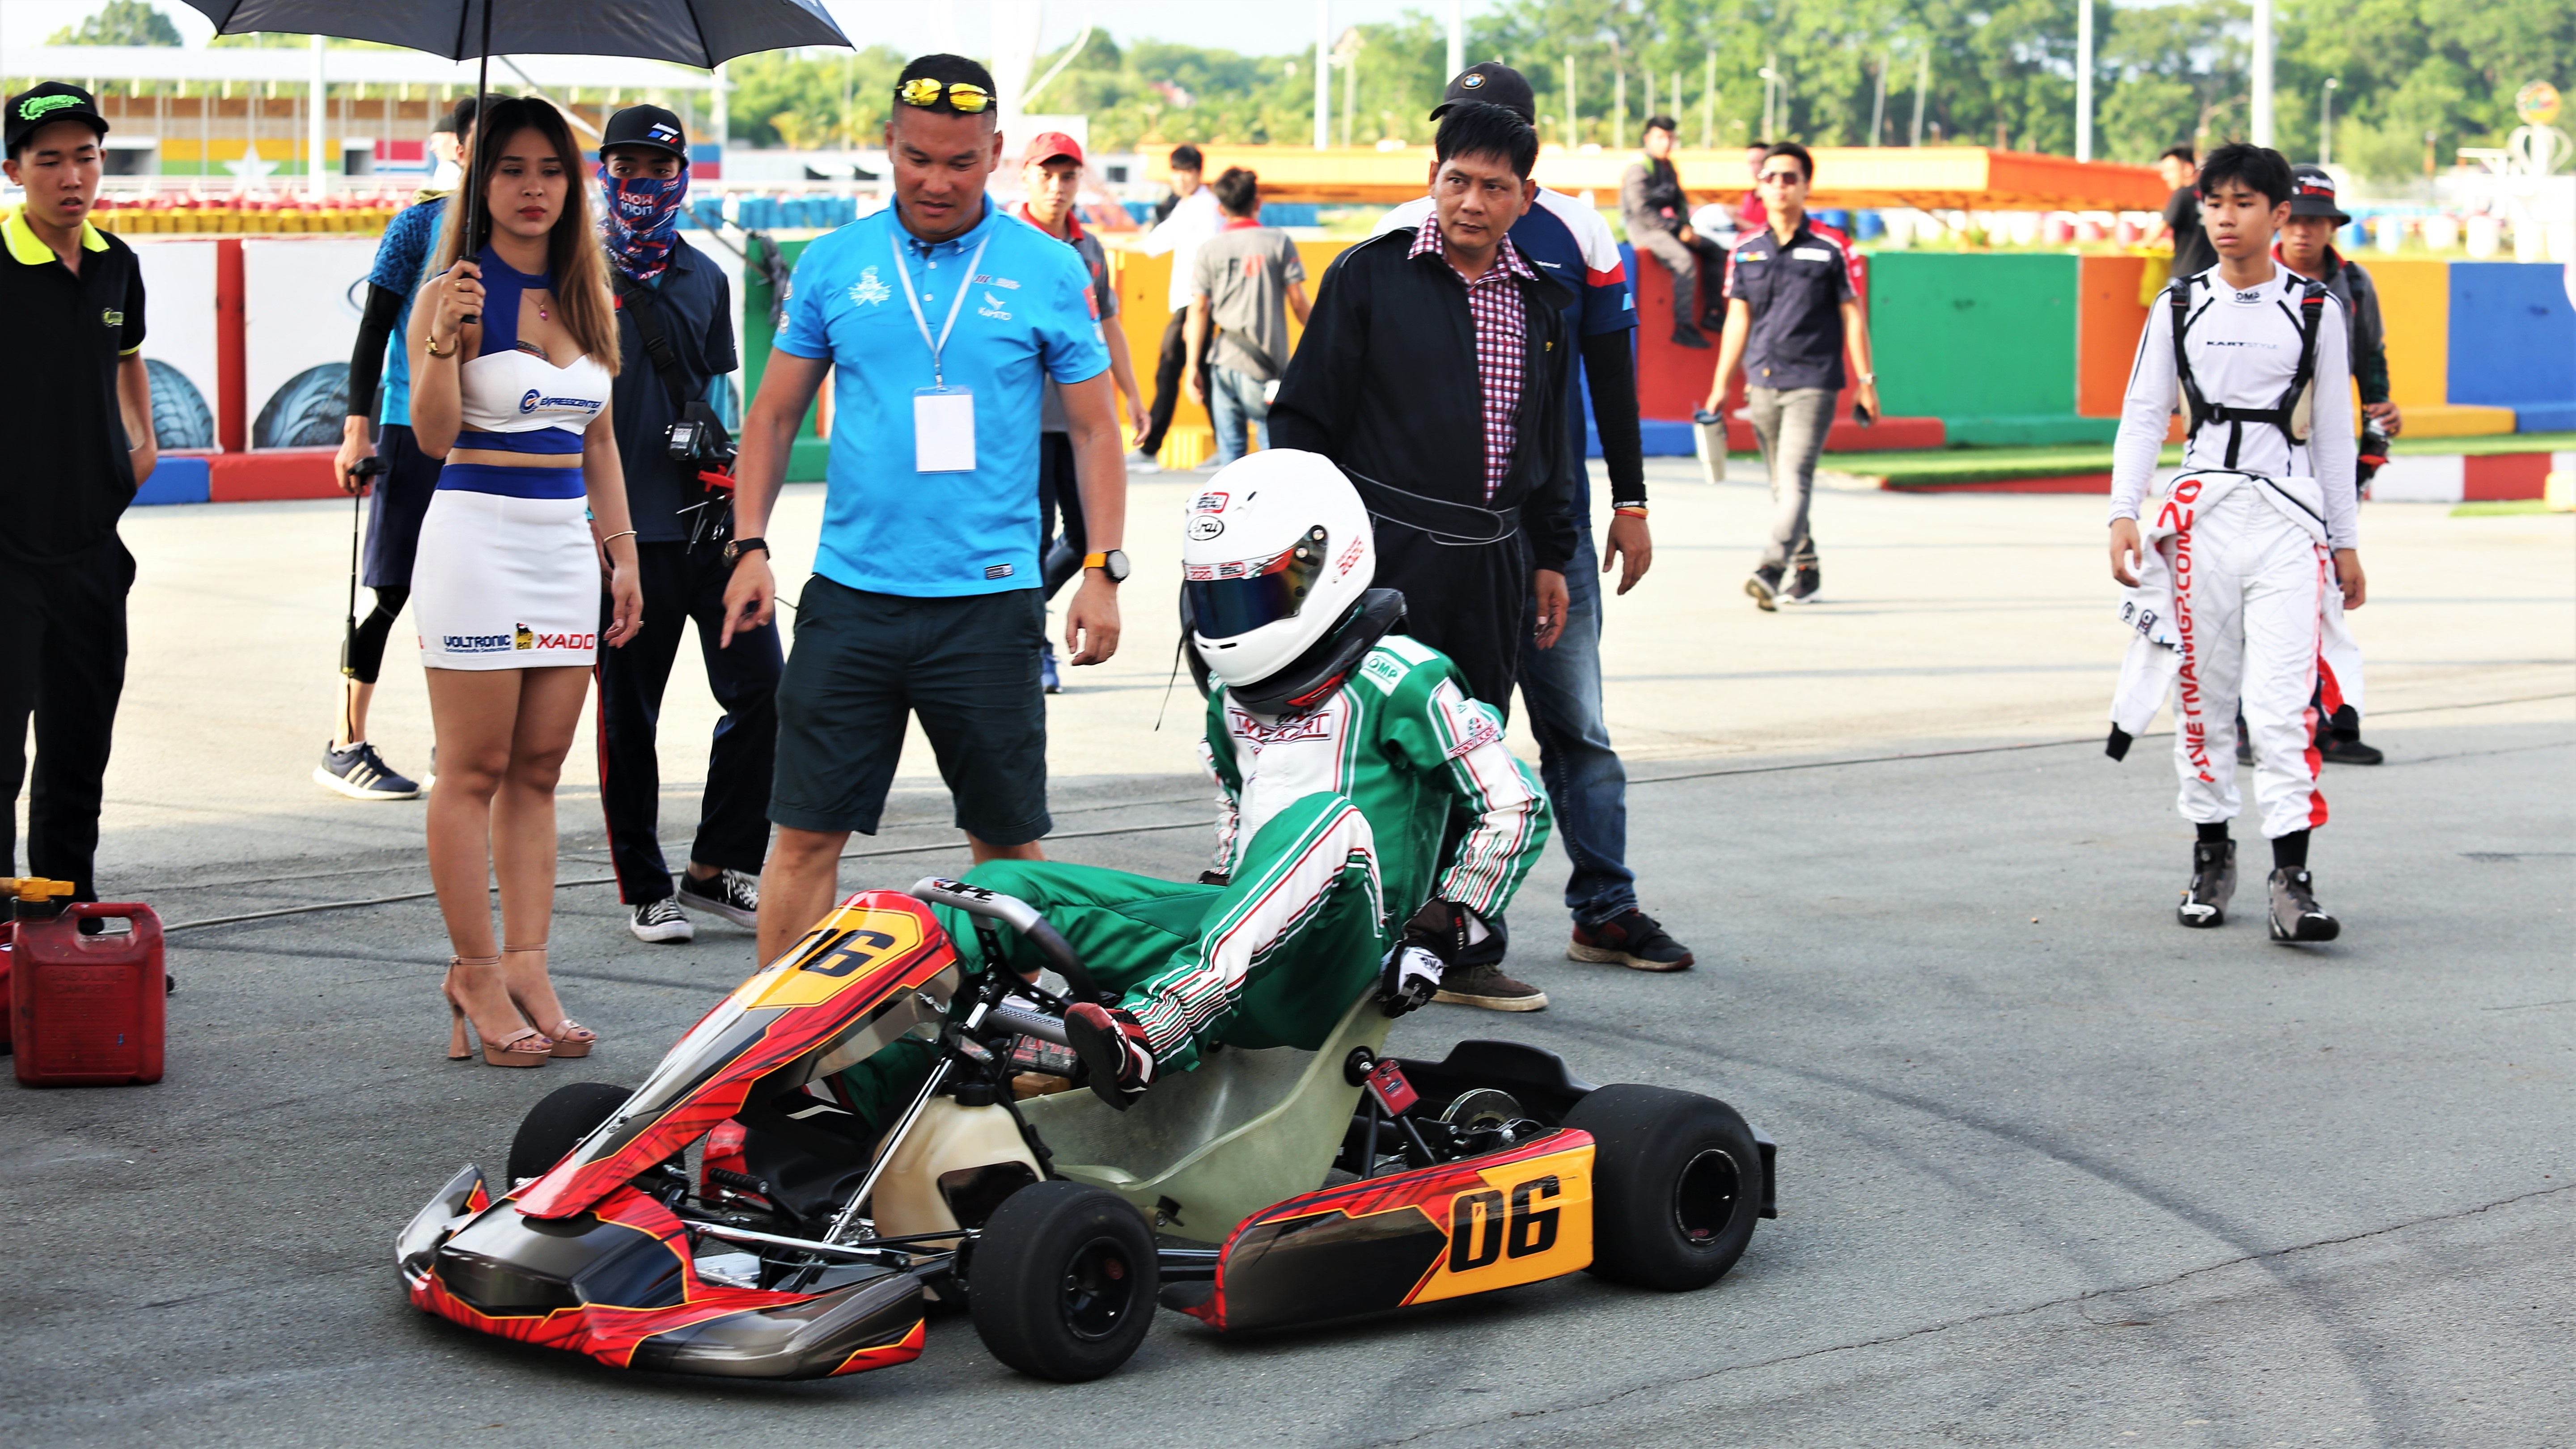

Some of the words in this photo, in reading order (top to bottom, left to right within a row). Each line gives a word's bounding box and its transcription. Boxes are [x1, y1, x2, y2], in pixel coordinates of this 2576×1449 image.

[619, 192, 653, 205] MOLY
[2236, 292, 2260, 301] OMP
[443, 634, 511, 648] VOLTRONIC
[536, 634, 595, 649] XADO
[1369, 657, 1398, 678] OMP
[1449, 1174, 1561, 1273] 06
